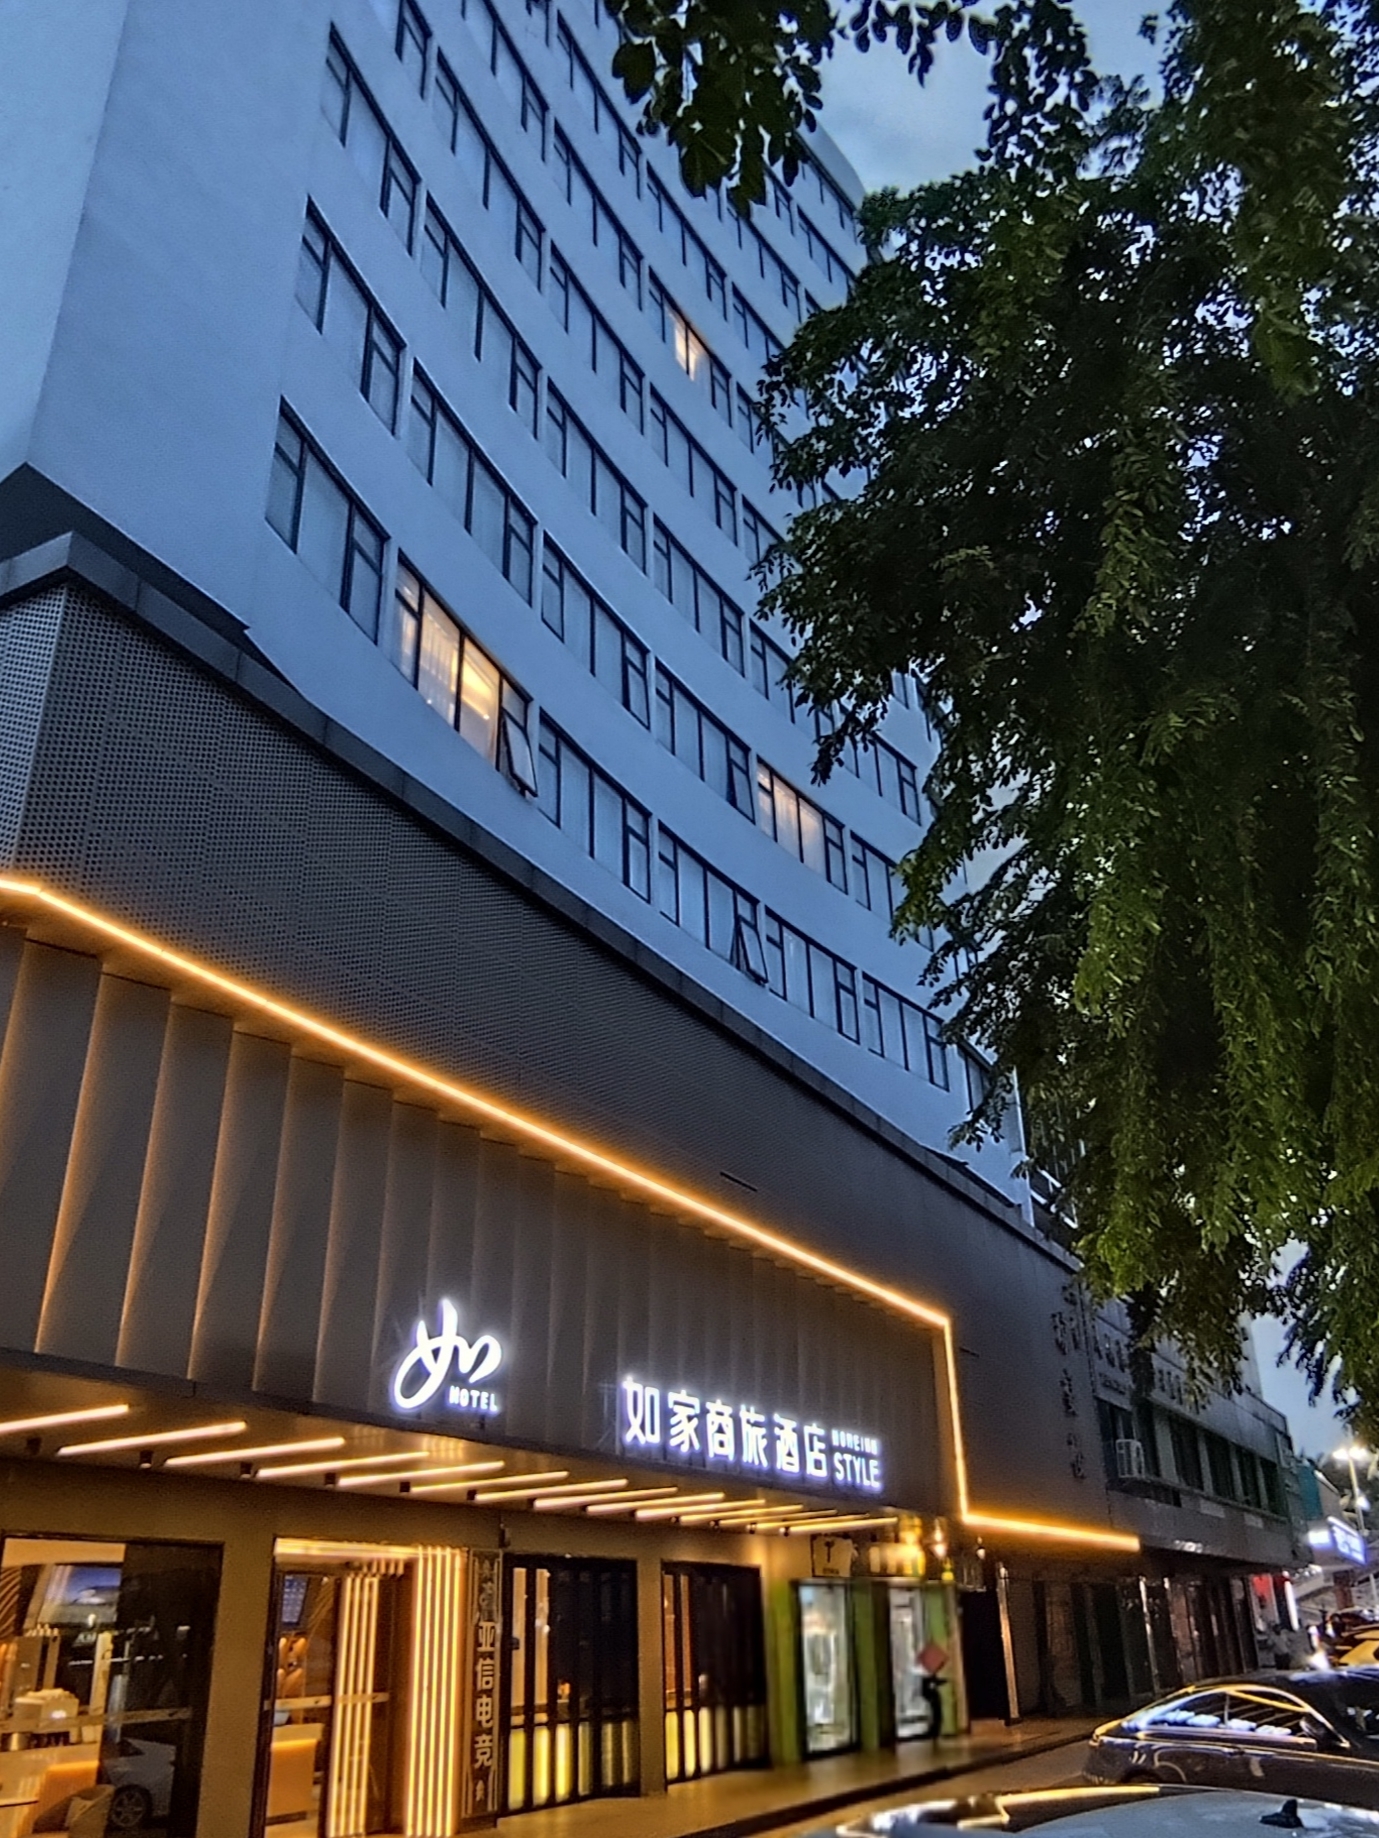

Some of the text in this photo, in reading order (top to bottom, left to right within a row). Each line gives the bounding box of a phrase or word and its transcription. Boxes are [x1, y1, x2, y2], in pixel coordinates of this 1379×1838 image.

[449, 1386, 498, 1412] HOTEL
[622, 1377, 828, 1478] 如家商旅酒店
[833, 1452, 881, 1489] STYLE
[474, 1621, 496, 1769] 亚信电竞
